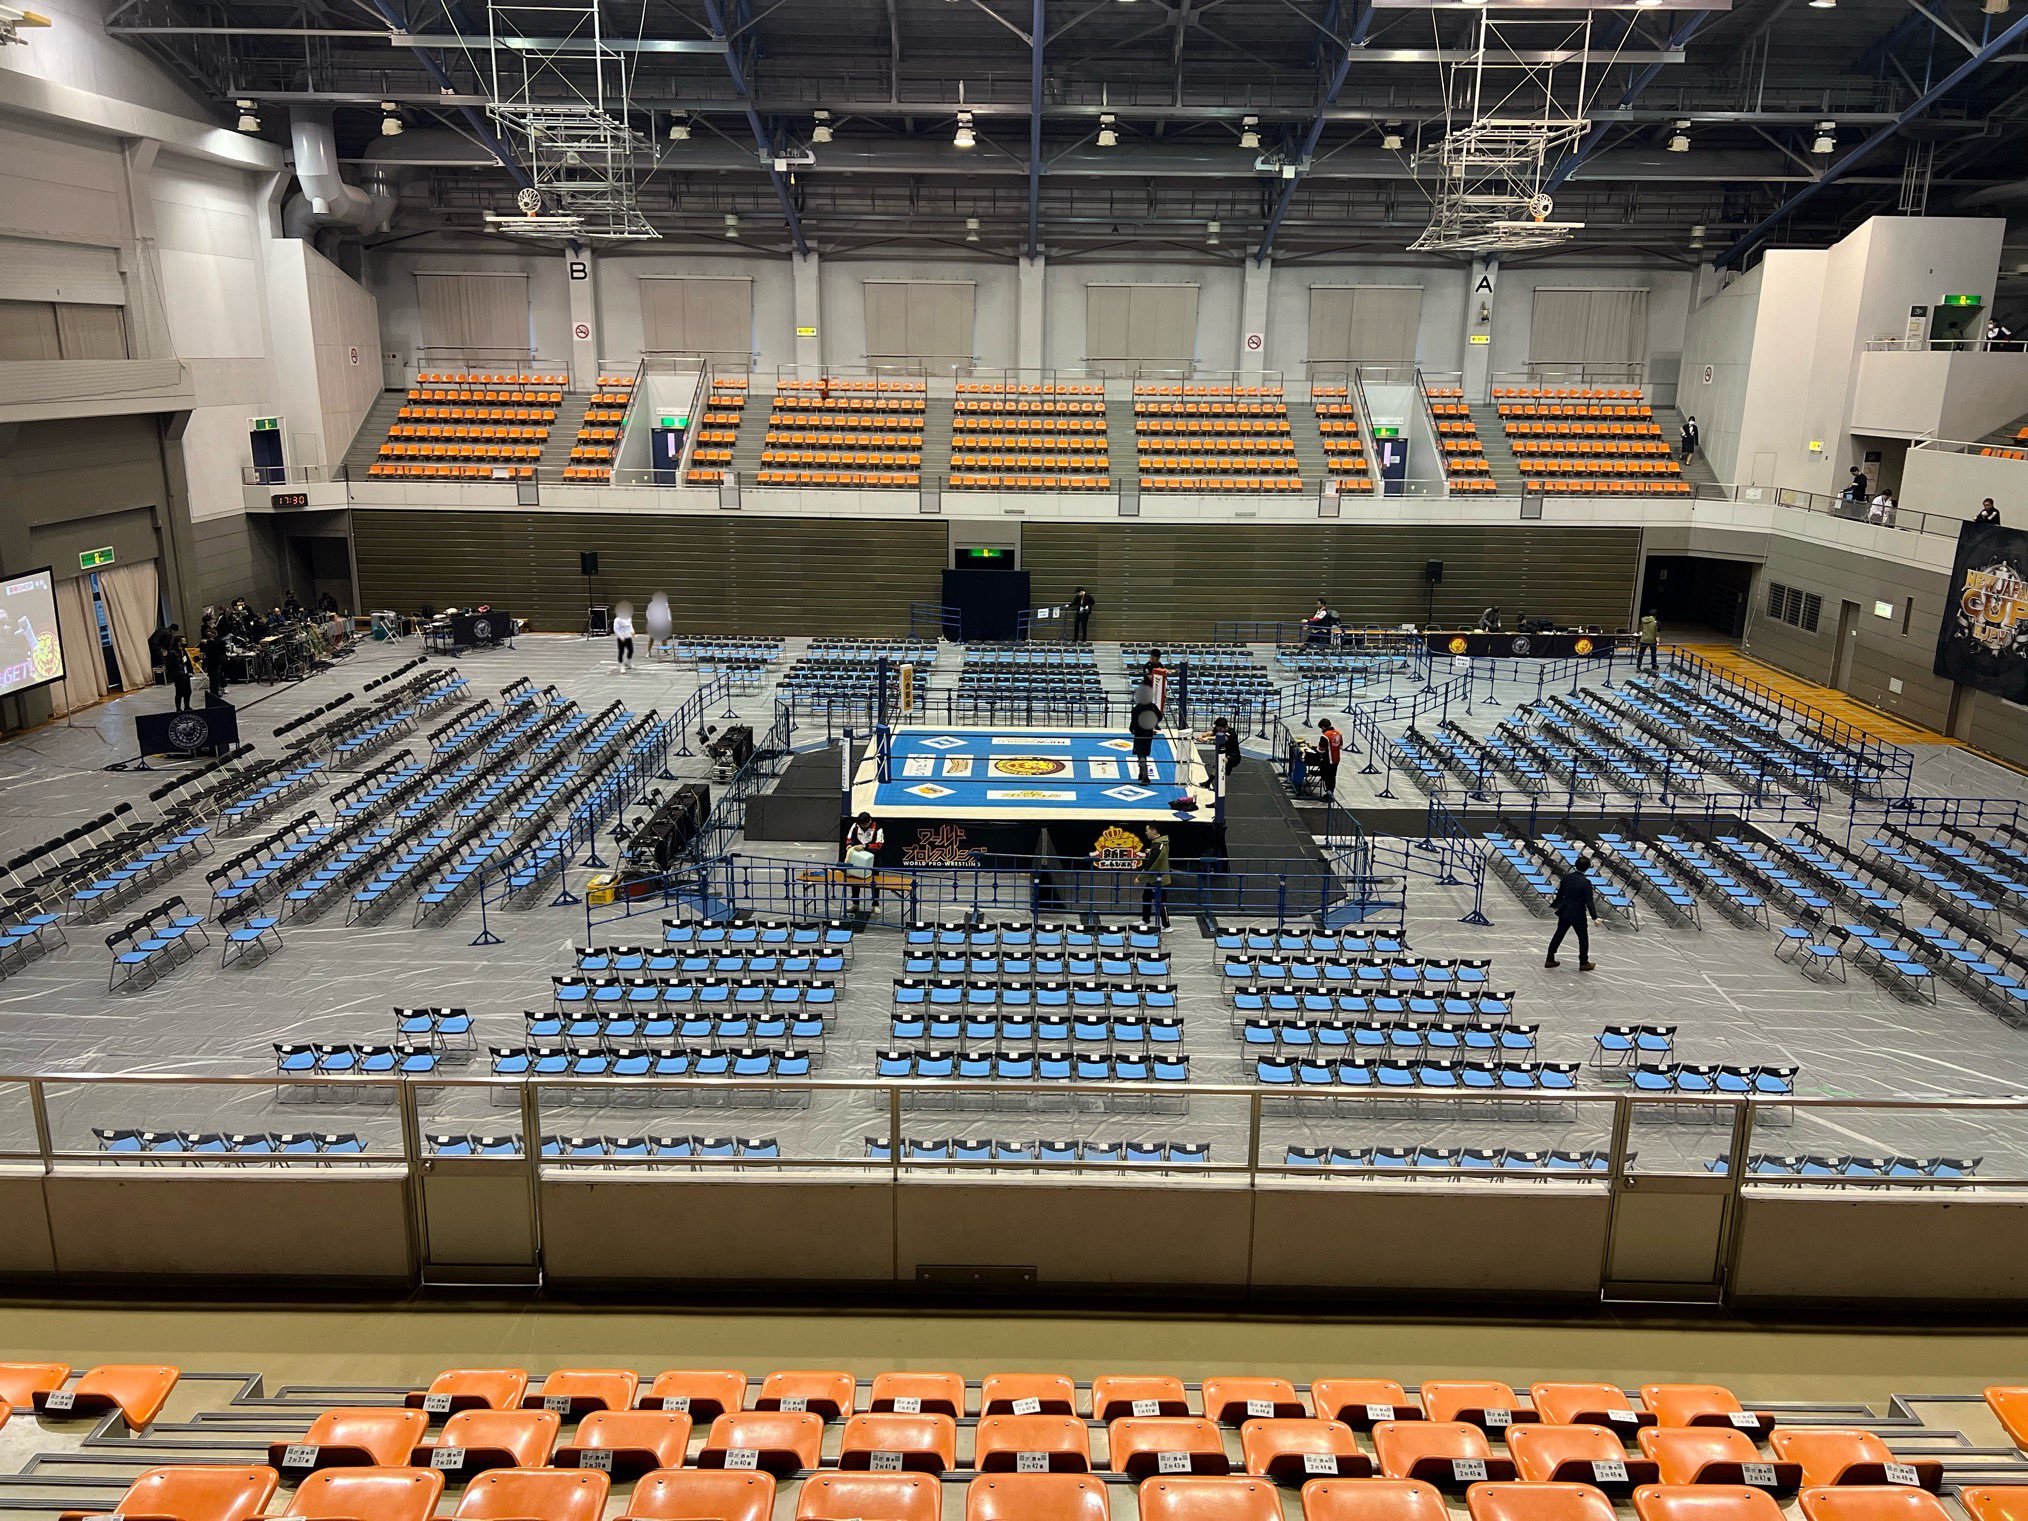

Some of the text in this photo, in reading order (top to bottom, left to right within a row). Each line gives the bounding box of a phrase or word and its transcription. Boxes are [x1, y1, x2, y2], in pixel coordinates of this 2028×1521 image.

[570, 262, 588, 280] B
[1475, 275, 1493, 293] A
[280, 496, 305, 505] 17:30
[1962, 569, 1997, 595] NEW
[1962, 588, 2028, 628] CUP
[1972, 622, 2011, 646] NJPW
[917, 824, 967, 847] ワールド
